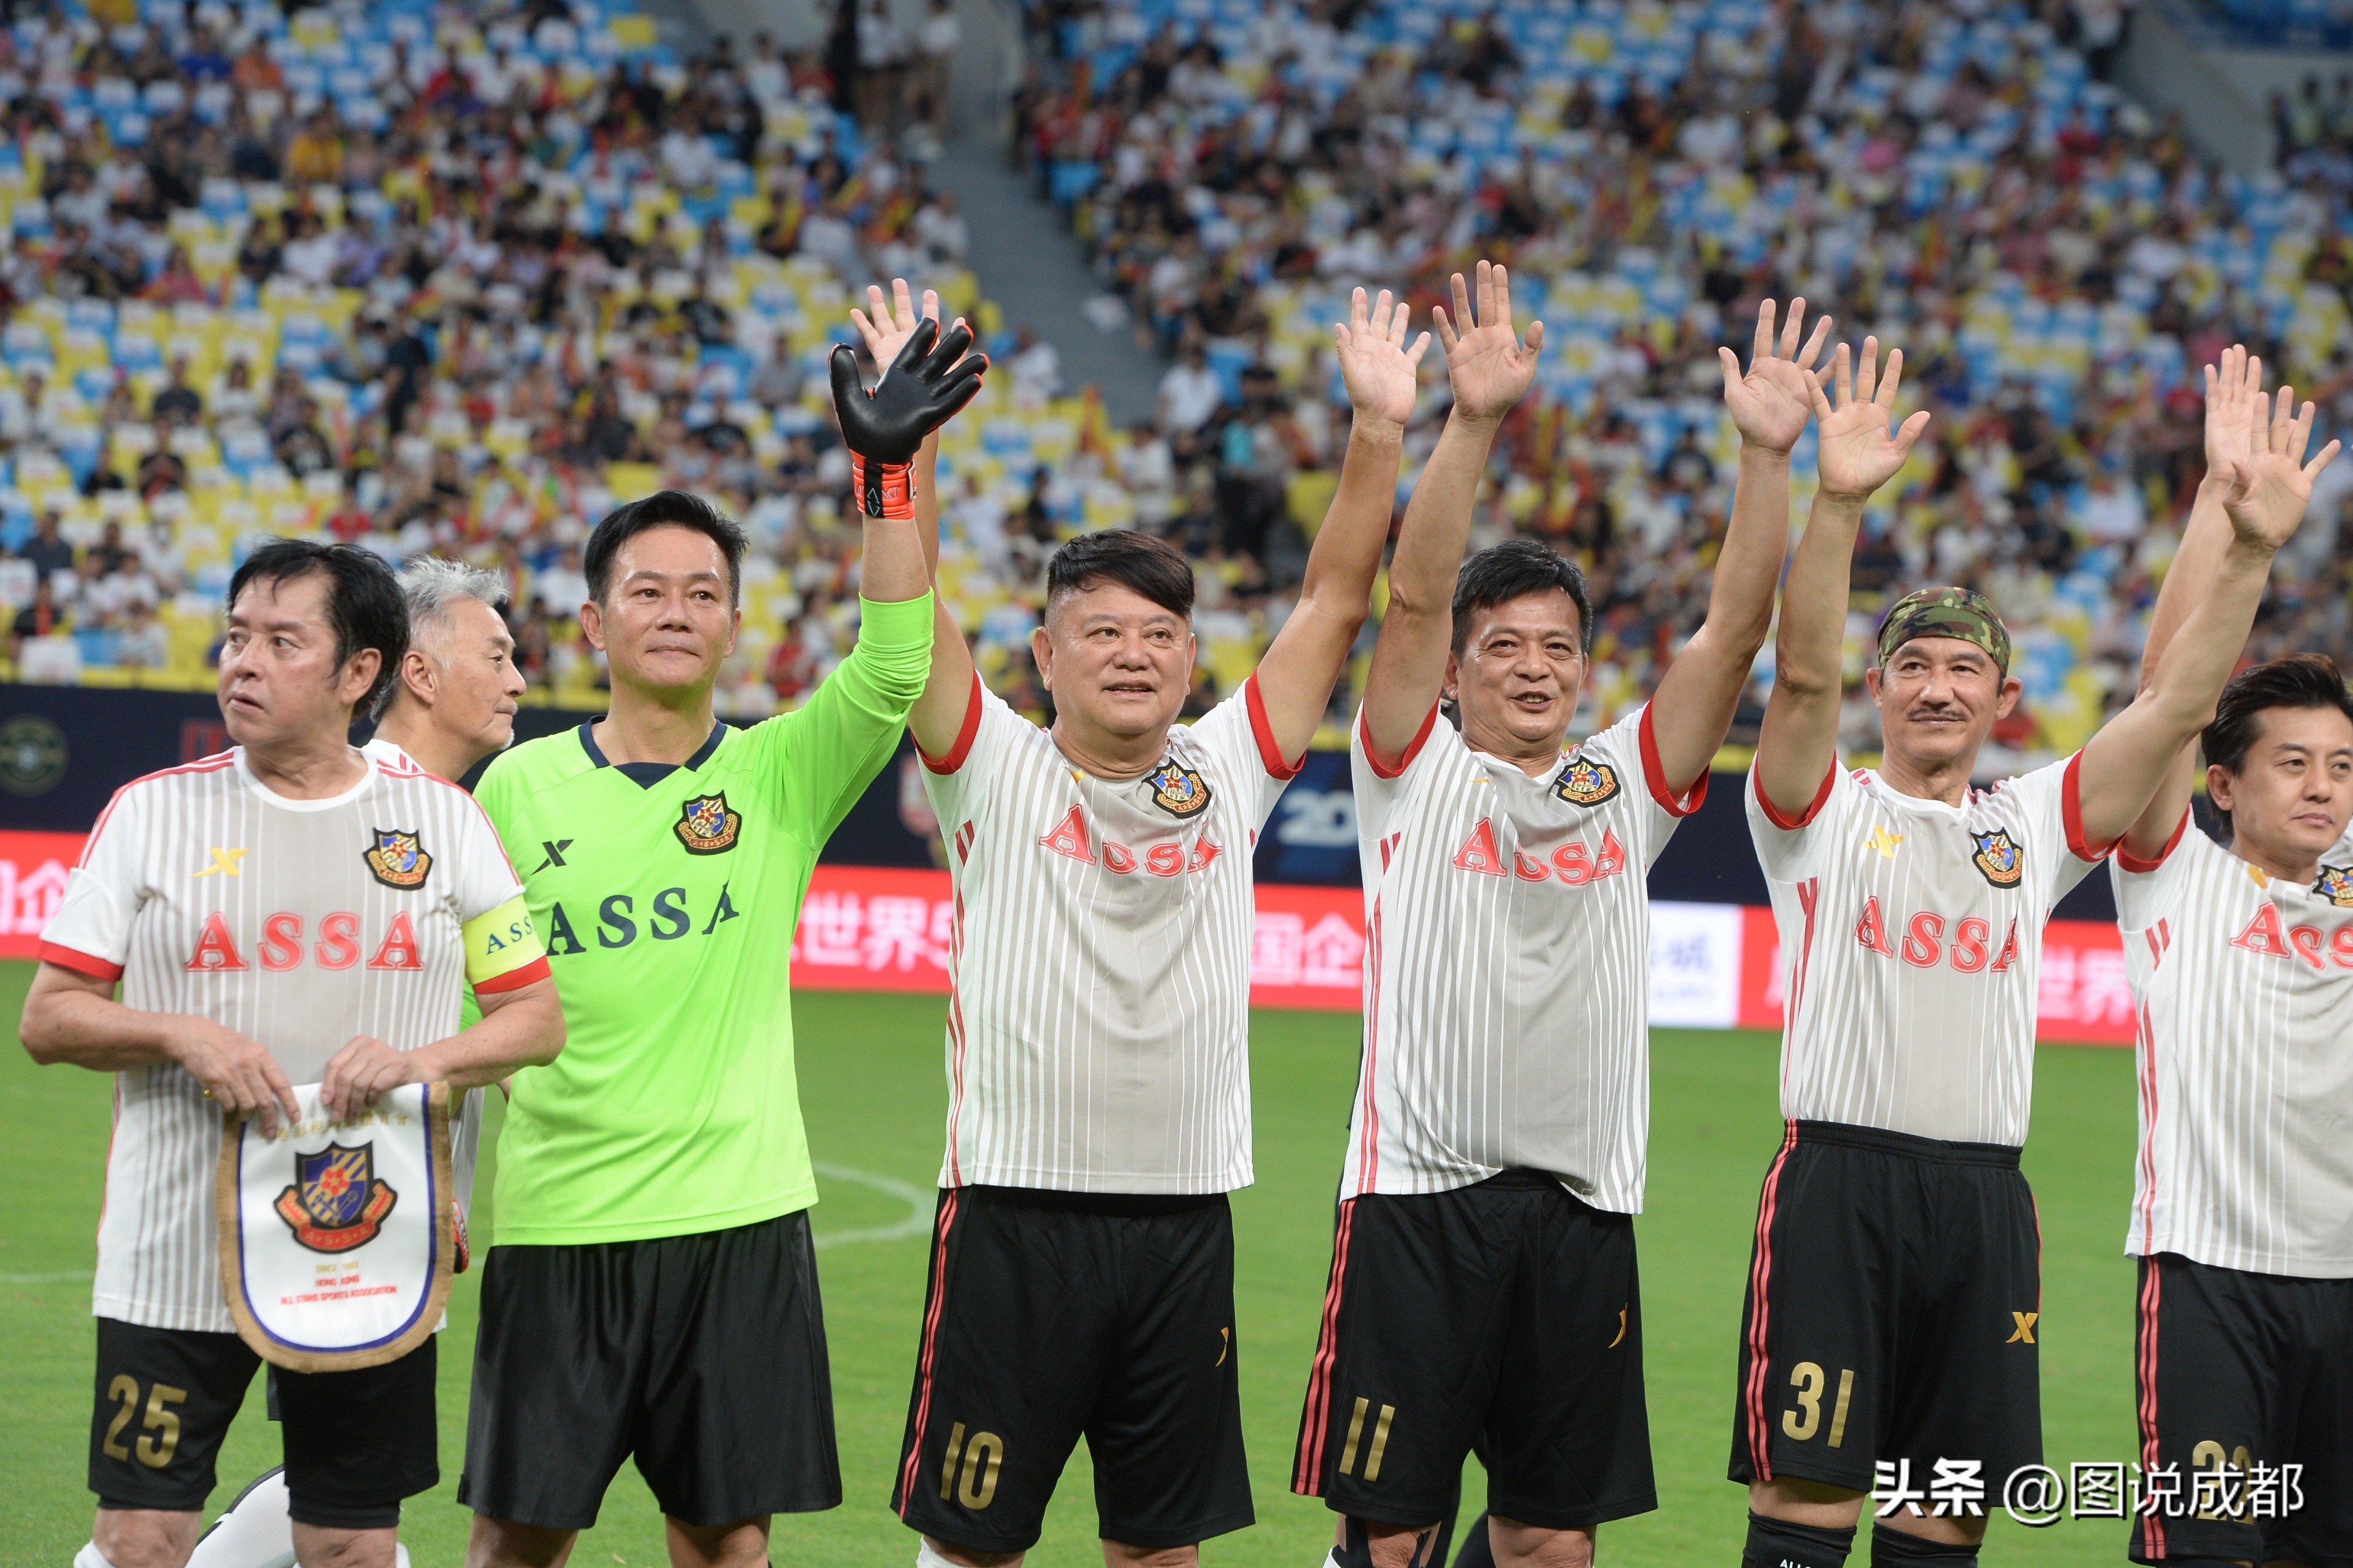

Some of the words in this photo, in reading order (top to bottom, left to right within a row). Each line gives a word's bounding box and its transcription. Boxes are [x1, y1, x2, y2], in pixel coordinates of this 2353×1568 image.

[185, 911, 424, 972] ASSA
[486, 915, 535, 955] ASS
[546, 879, 739, 956] ASSA
[1855, 896, 2018, 974] ASSA
[315, 1278, 336, 1287] HONG
[340, 1275, 360, 1286] KONG
[321, 1290, 348, 1300] SPORTS
[351, 1286, 397, 1298] ASSOCIATION
[102, 1373, 189, 1470] 25
[1339, 1397, 1395, 1483] 11
[1782, 1361, 1855, 1449] 31
[939, 1422, 1004, 1511] 10
